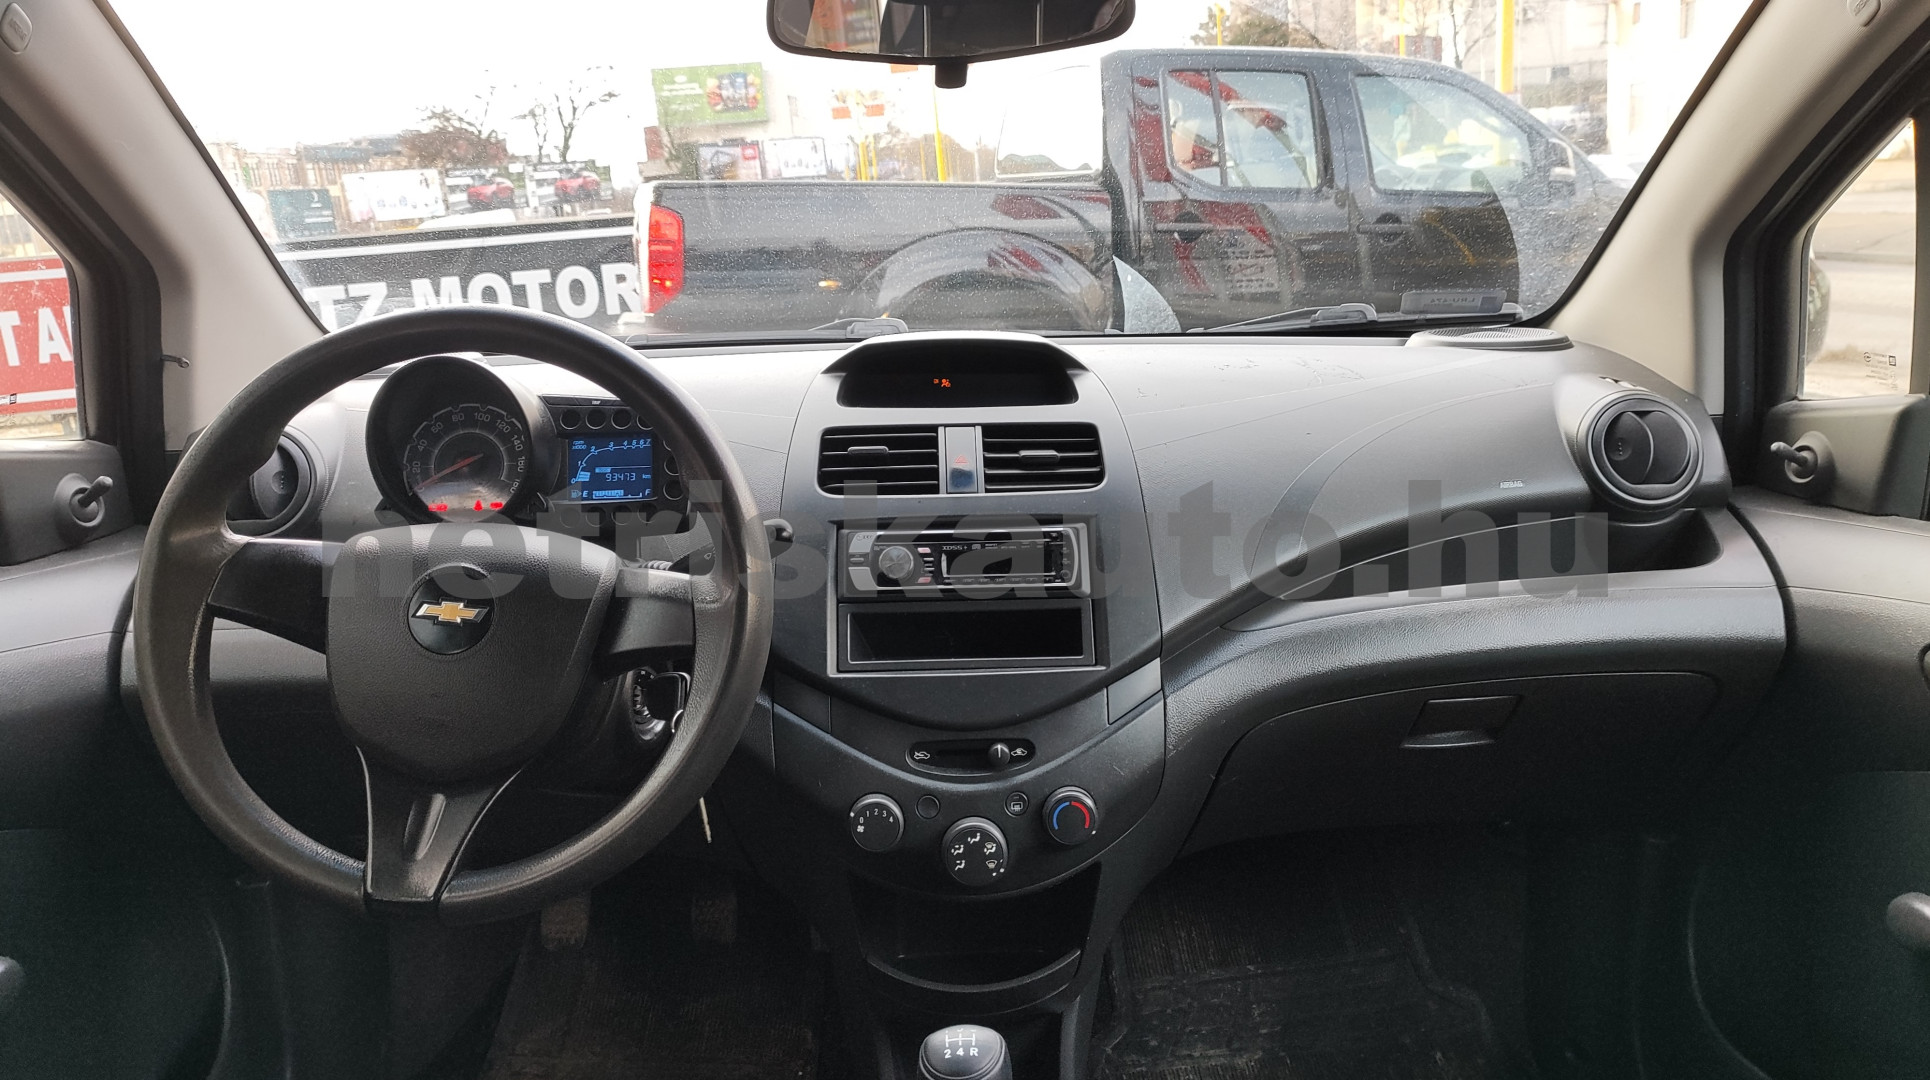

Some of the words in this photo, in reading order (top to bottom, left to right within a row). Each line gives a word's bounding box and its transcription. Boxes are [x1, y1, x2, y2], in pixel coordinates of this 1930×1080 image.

[451, 412, 465, 422] 80
[473, 412, 491, 422] 100
[431, 422, 443, 433] 60
[495, 419, 511, 434] 120
[417, 439, 428, 452] 40
[511, 434, 524, 451] 140
[412, 460, 421, 473] 20
[605, 472, 636, 482] 93473
[582, 490, 589, 498] E
[858, 816, 865, 824] 0
[865, 810, 870, 818] 1
[873, 808, 879, 816] 2
[881, 810, 888, 818] 3
[888, 816, 895, 824] 4
[943, 1048, 952, 1059] 2
[956, 1047, 965, 1057] 4
[969, 1047, 979, 1057] R
